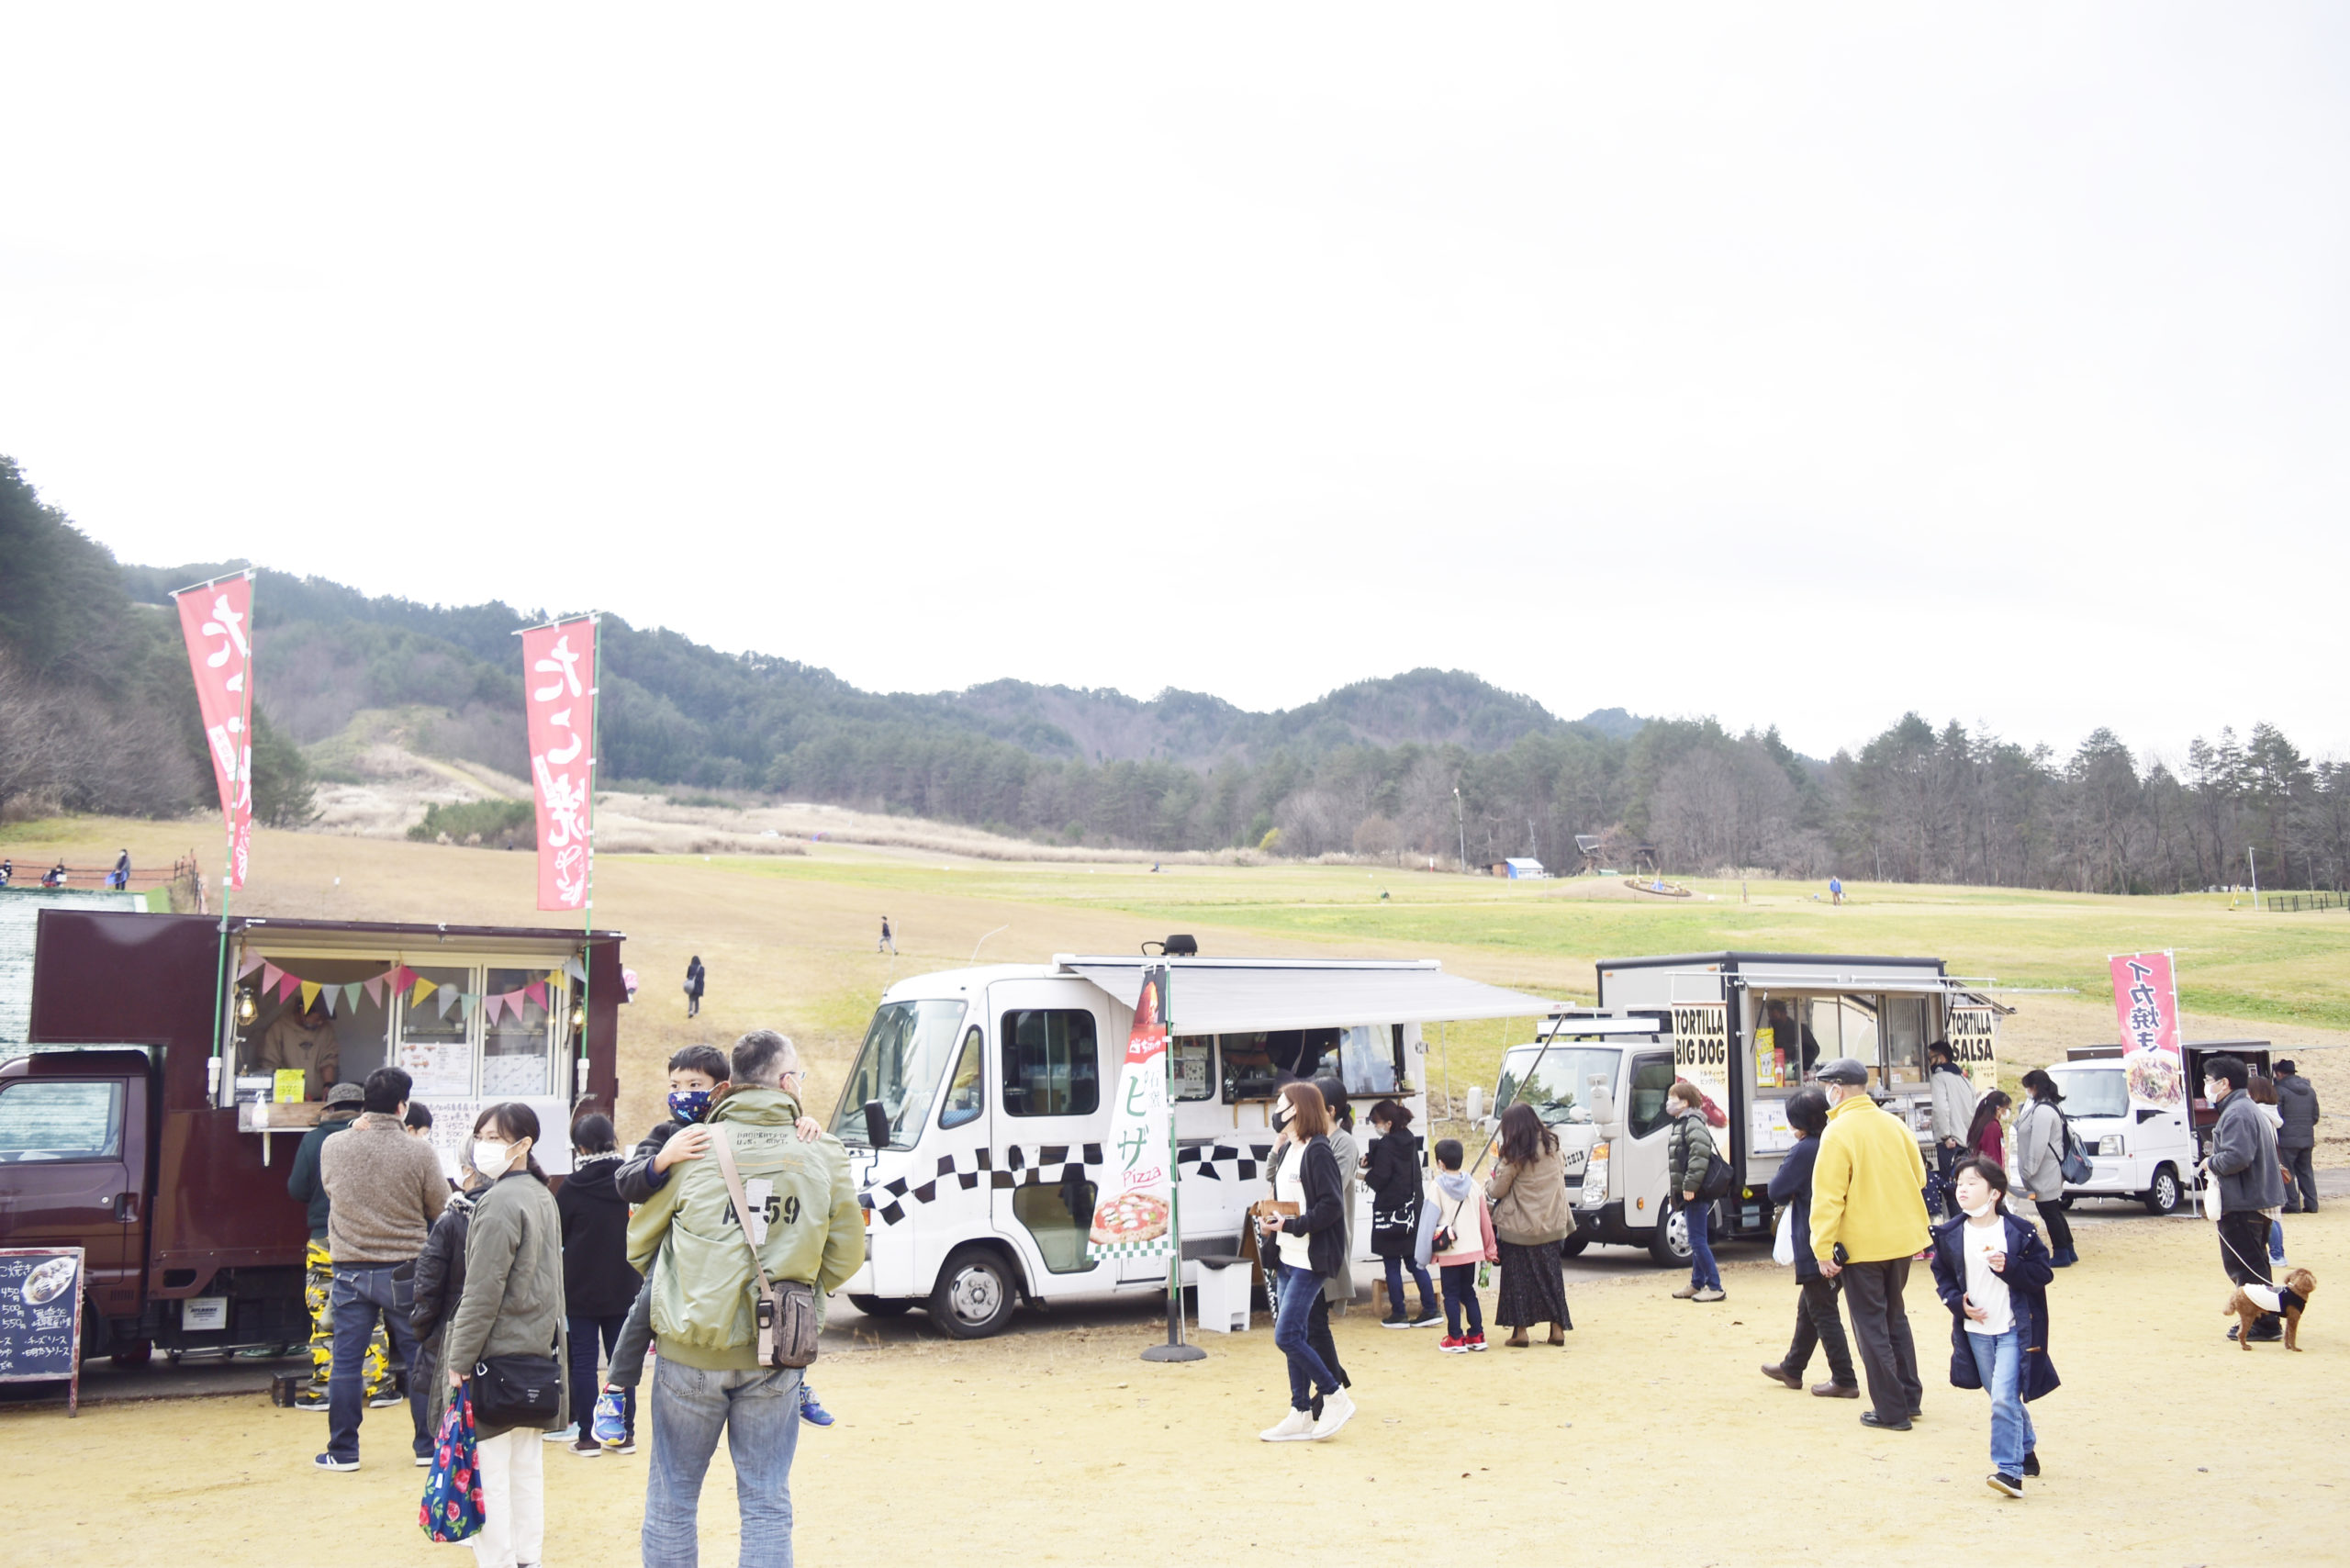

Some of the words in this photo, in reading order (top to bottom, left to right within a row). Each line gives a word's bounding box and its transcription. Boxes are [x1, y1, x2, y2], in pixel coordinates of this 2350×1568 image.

[1674, 1009, 1724, 1035] TORTILLA
[1952, 1013, 1992, 1036] TORTILLA
[1675, 1038, 1695, 1065] BIG
[1698, 1038, 1725, 1065] DOG
[1952, 1038, 1994, 1062] SALSA
[1117, 1070, 1149, 1171] ピザ
[1123, 1166, 1161, 1187] Pizza
[722, 1195, 800, 1225] A-59
